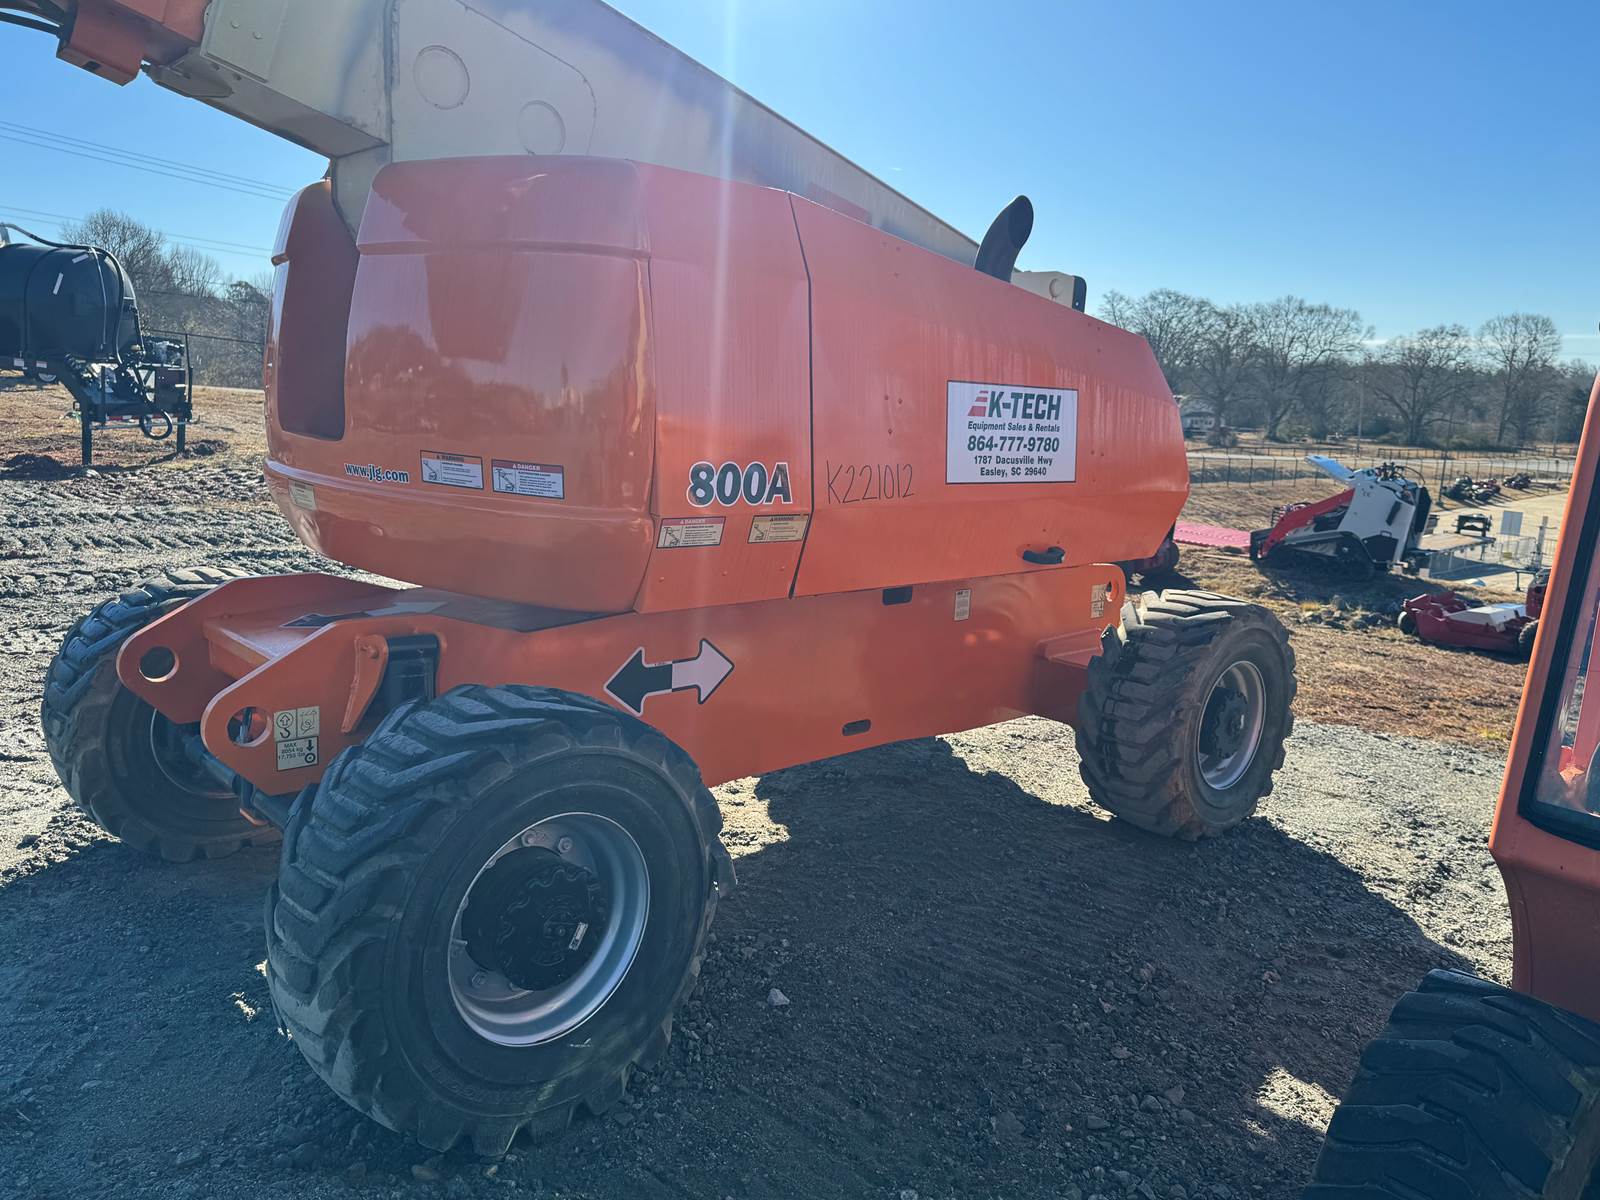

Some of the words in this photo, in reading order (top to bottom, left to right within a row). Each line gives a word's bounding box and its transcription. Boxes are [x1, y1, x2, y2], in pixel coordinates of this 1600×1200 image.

[988, 390, 1061, 420] K-TECH
[967, 421, 1006, 431] Equipment
[1007, 422, 1026, 431] Sales
[1027, 423, 1034, 431] &
[1035, 423, 1060, 432] Rentals
[967, 435, 1060, 452] 864-777-9780
[974, 455, 992, 464] 1787
[995, 455, 1035, 464] Dacusville
[1037, 455, 1053, 466] Hwy
[344, 463, 410, 483] www.jlg.com
[980, 467, 1008, 477] Easley,
[1011, 467, 1021, 476] SC
[1024, 467, 1047, 476] 29640
[686, 461, 793, 507] 800A
[826, 459, 915, 504] K221012
